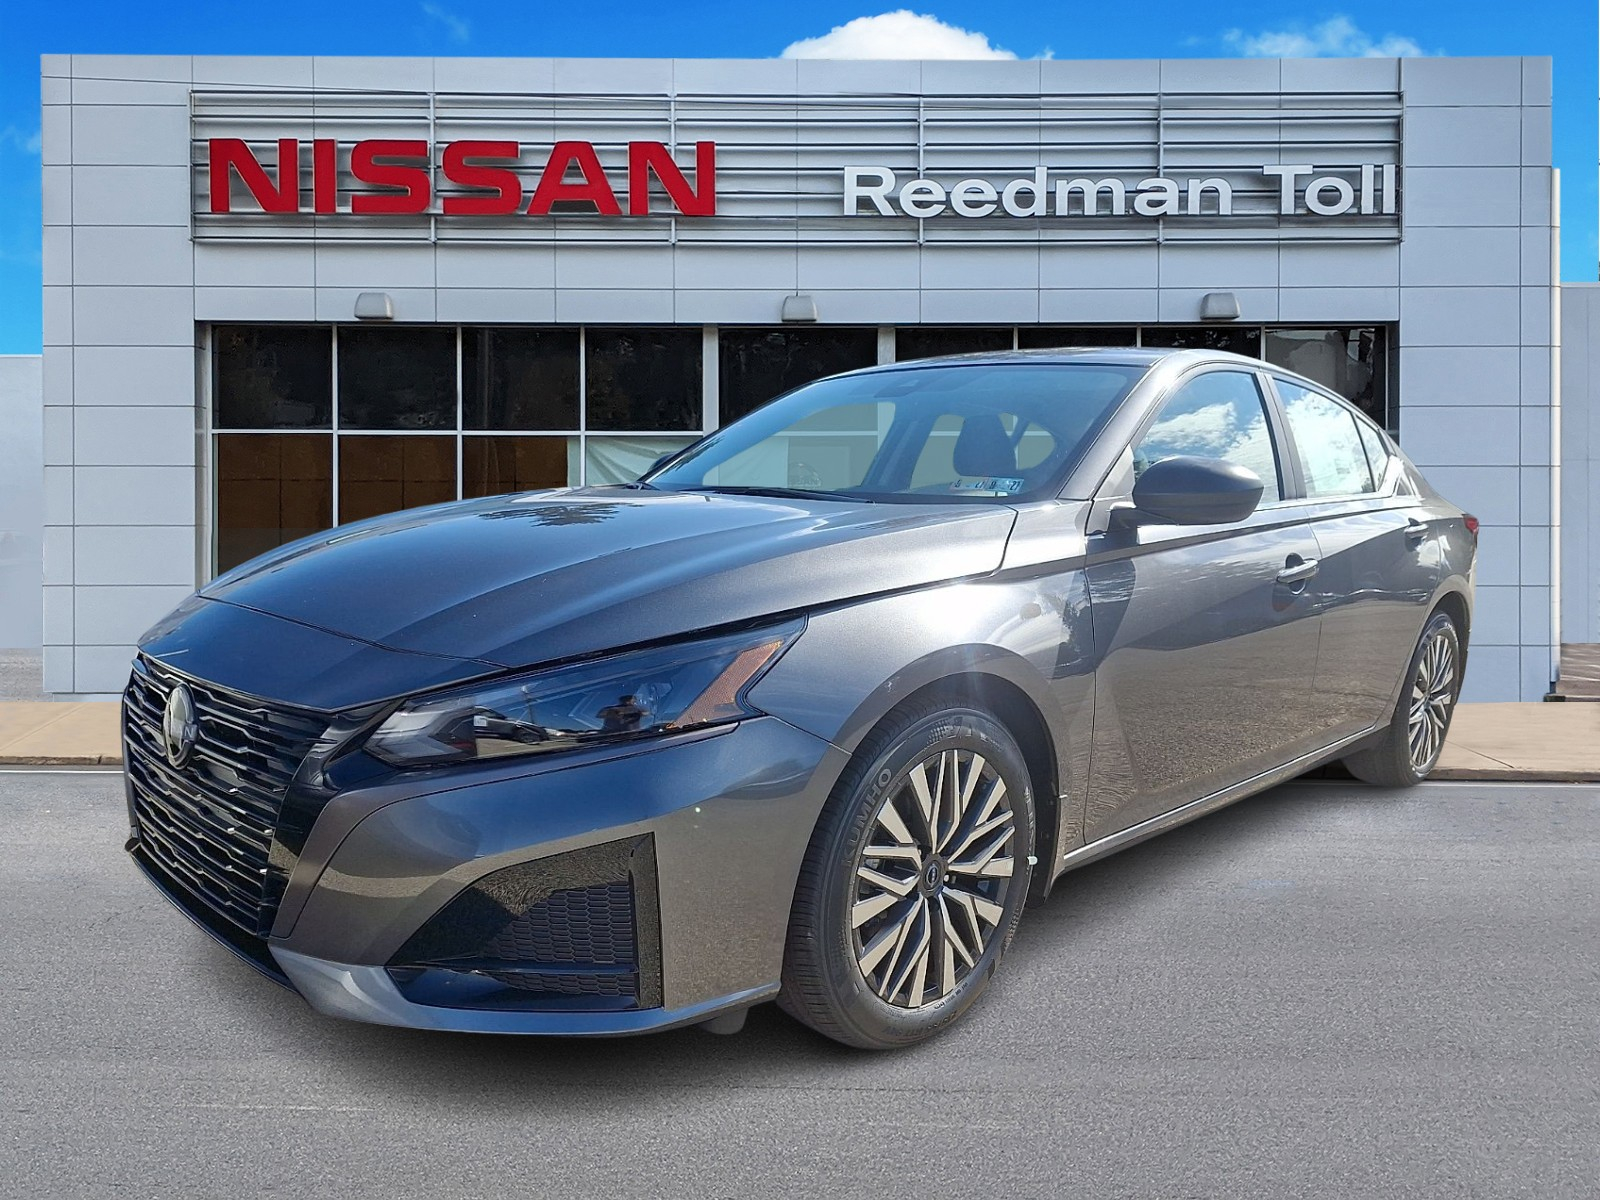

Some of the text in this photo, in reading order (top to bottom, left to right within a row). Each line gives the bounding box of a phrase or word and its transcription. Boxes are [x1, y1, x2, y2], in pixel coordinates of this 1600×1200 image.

[209, 138, 716, 217] NISSAN
[843, 164, 1397, 219] Reedman Toll
[841, 768, 892, 866] KUMHO
